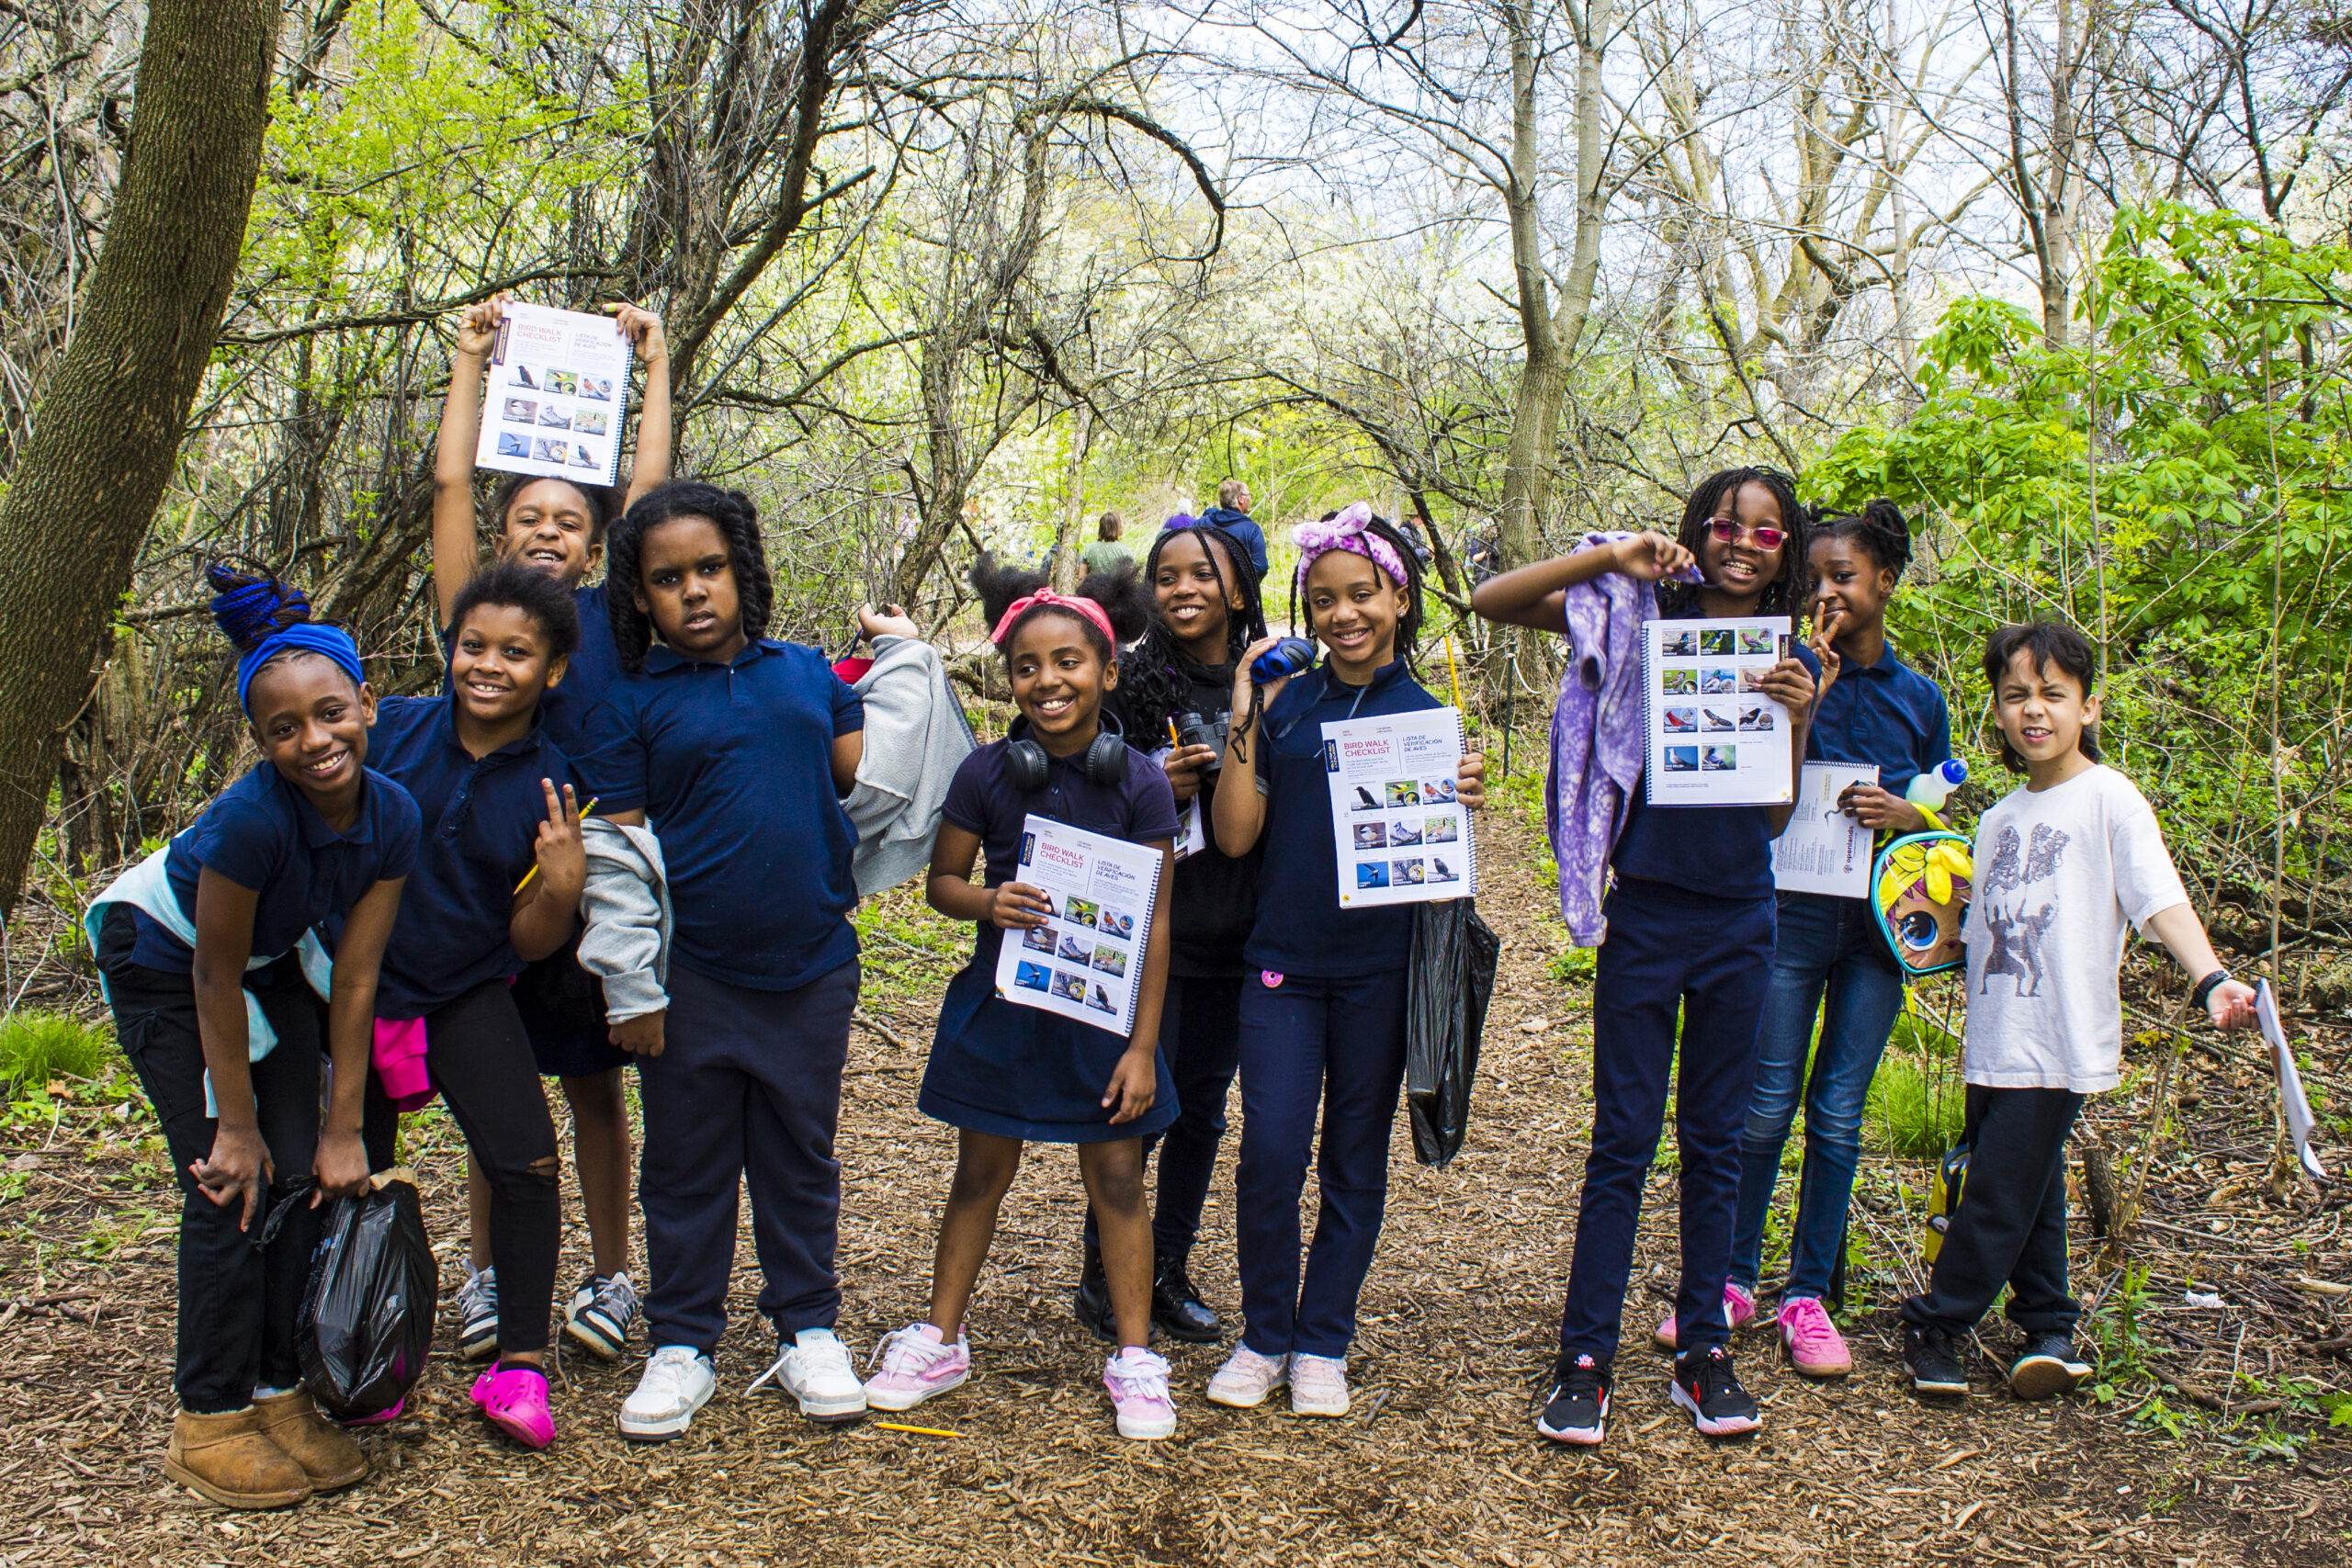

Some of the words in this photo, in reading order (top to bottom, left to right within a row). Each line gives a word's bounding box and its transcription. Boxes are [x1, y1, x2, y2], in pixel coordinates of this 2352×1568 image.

[518, 323, 537, 333] BIRD
[538, 327, 561, 336] WALK
[516, 331, 562, 343] CHECKLIST
[1344, 741, 1363, 750] BIRD
[1365, 739, 1389, 748] WALK
[1345, 747, 1390, 757] CHECKLIST
[1846, 826, 1854, 863] openlands
[1041, 842, 1060, 853] BIRD
[1062, 849, 1085, 862] WALK
[1040, 851, 1084, 869] CHECKLIST
[1098, 860, 1113, 868] LISTA
[1103, 872, 1119, 881] AVES
